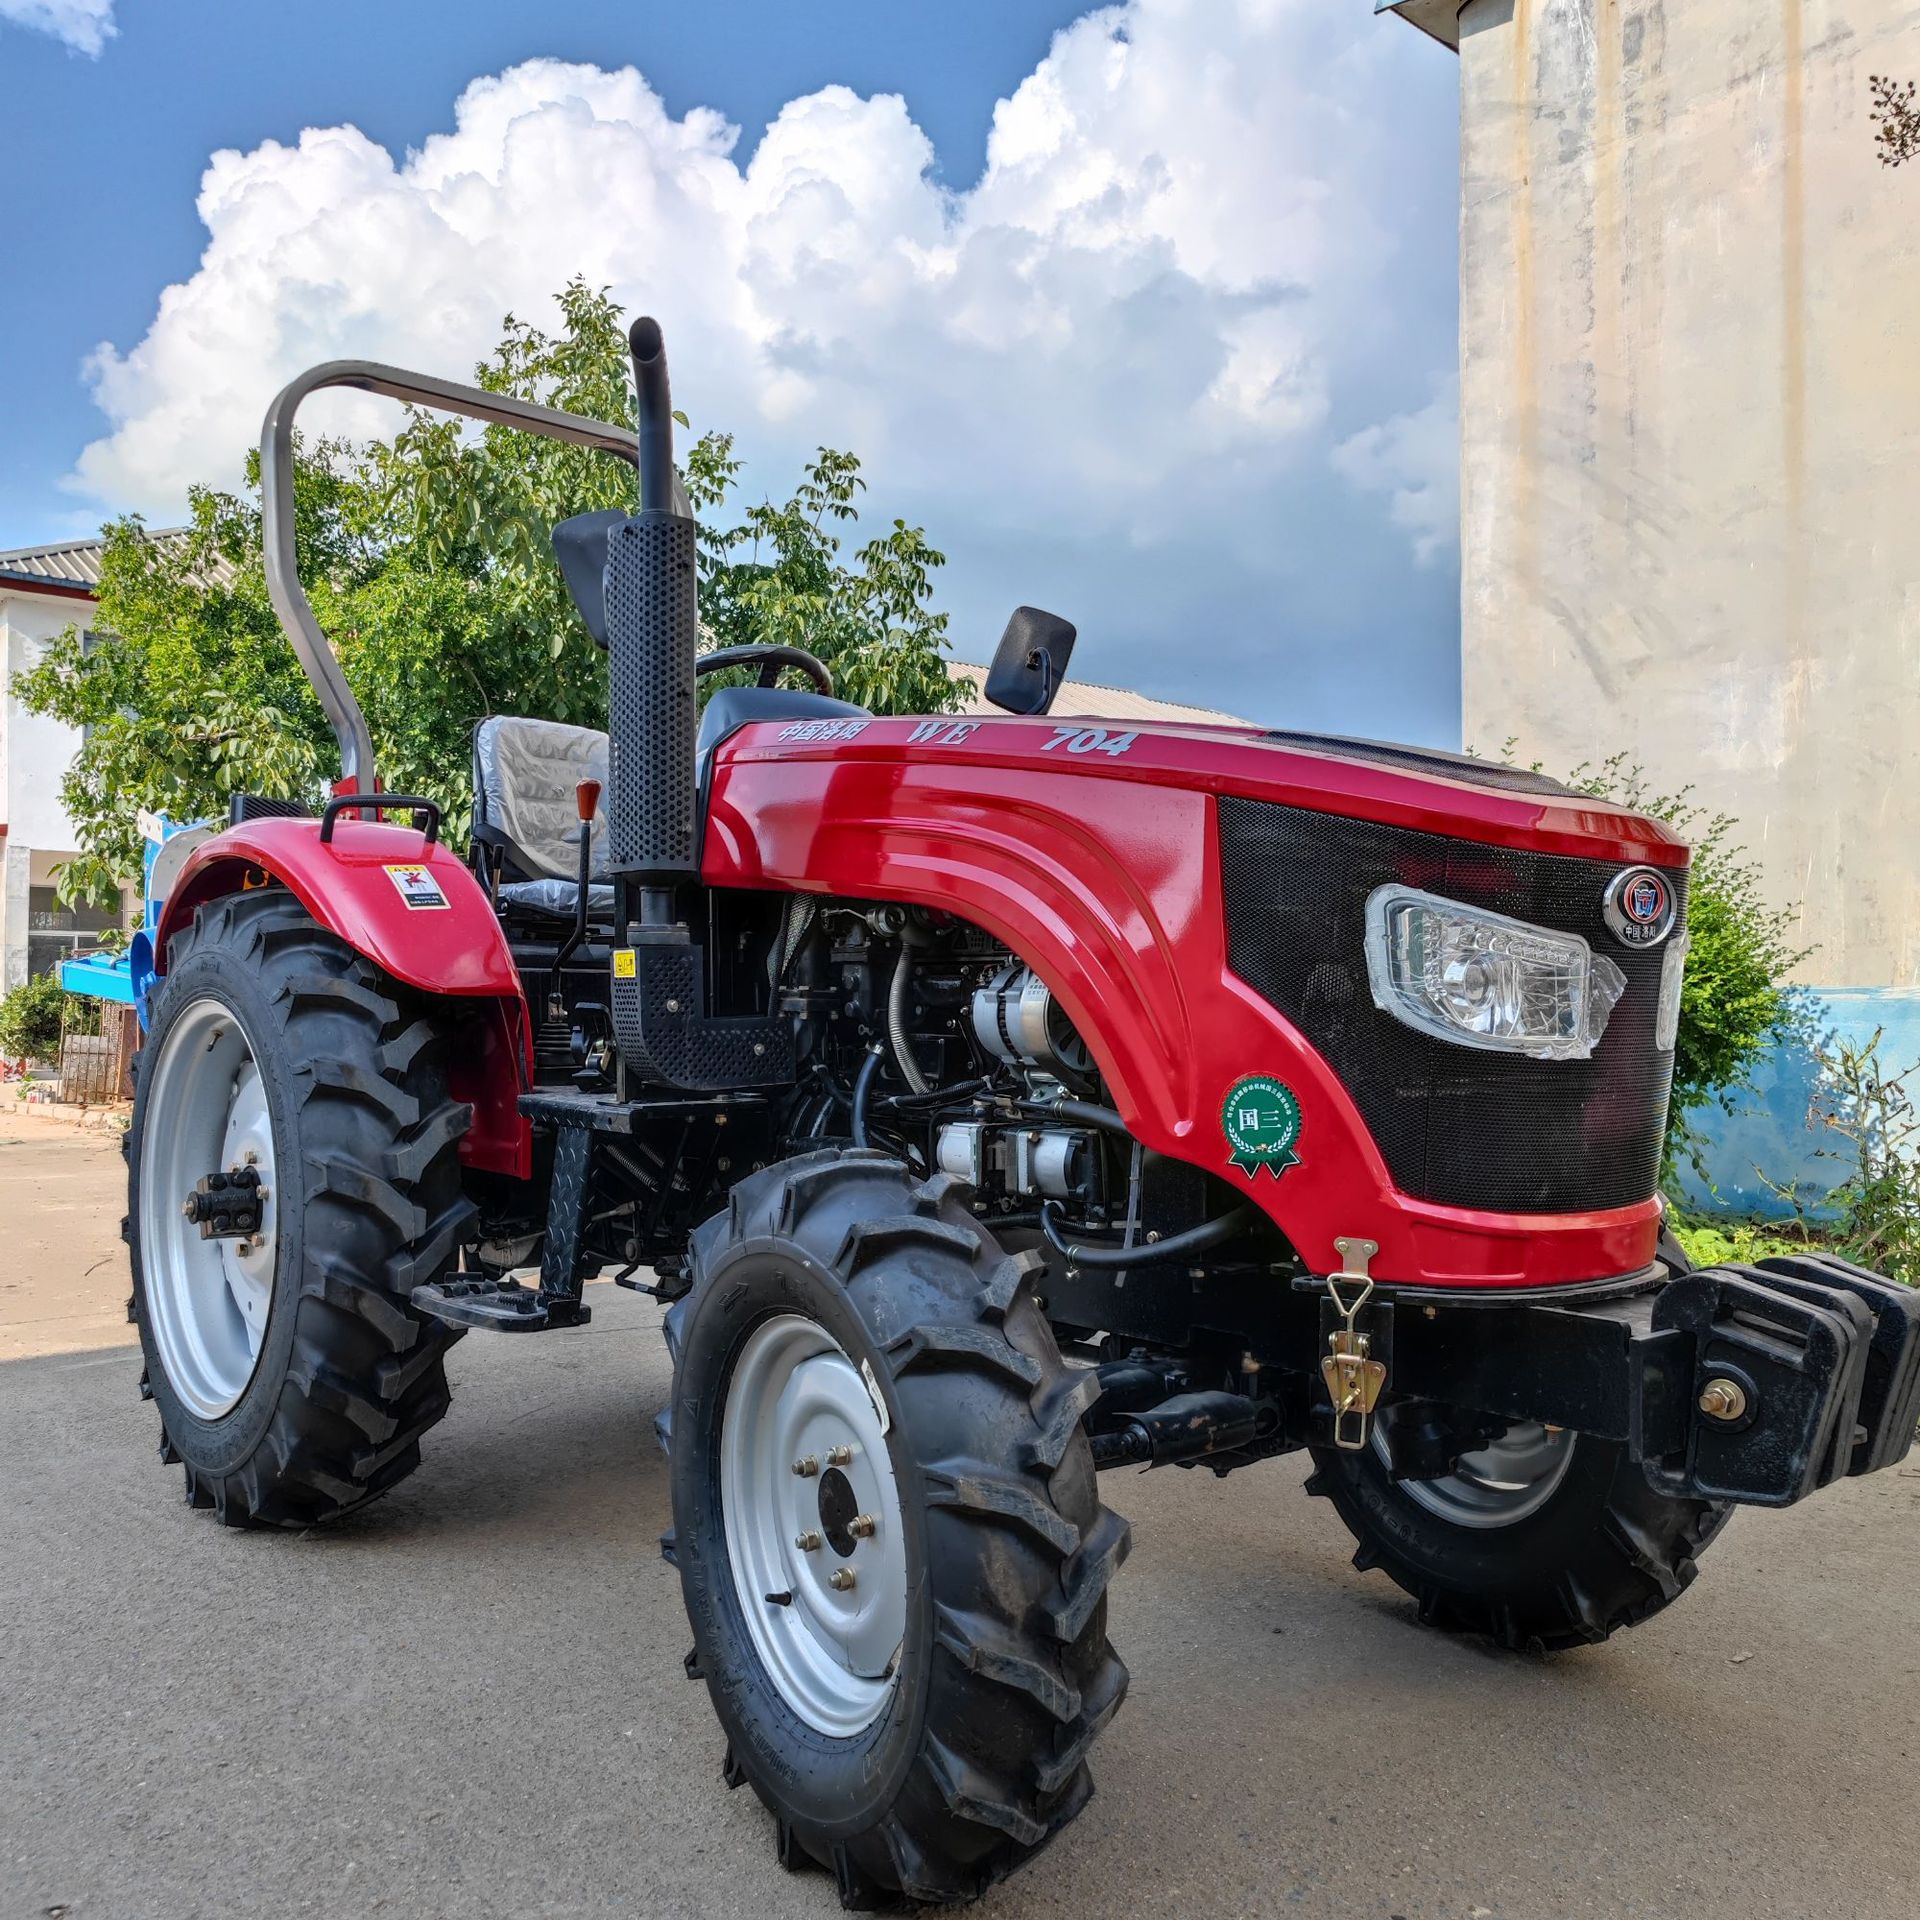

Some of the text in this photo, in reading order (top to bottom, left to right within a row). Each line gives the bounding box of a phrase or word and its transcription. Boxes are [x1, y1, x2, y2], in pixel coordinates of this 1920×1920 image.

[906, 721, 983, 745] WE
[1040, 727, 1140, 756] 704
[1239, 1109, 1281, 1131] 国三
